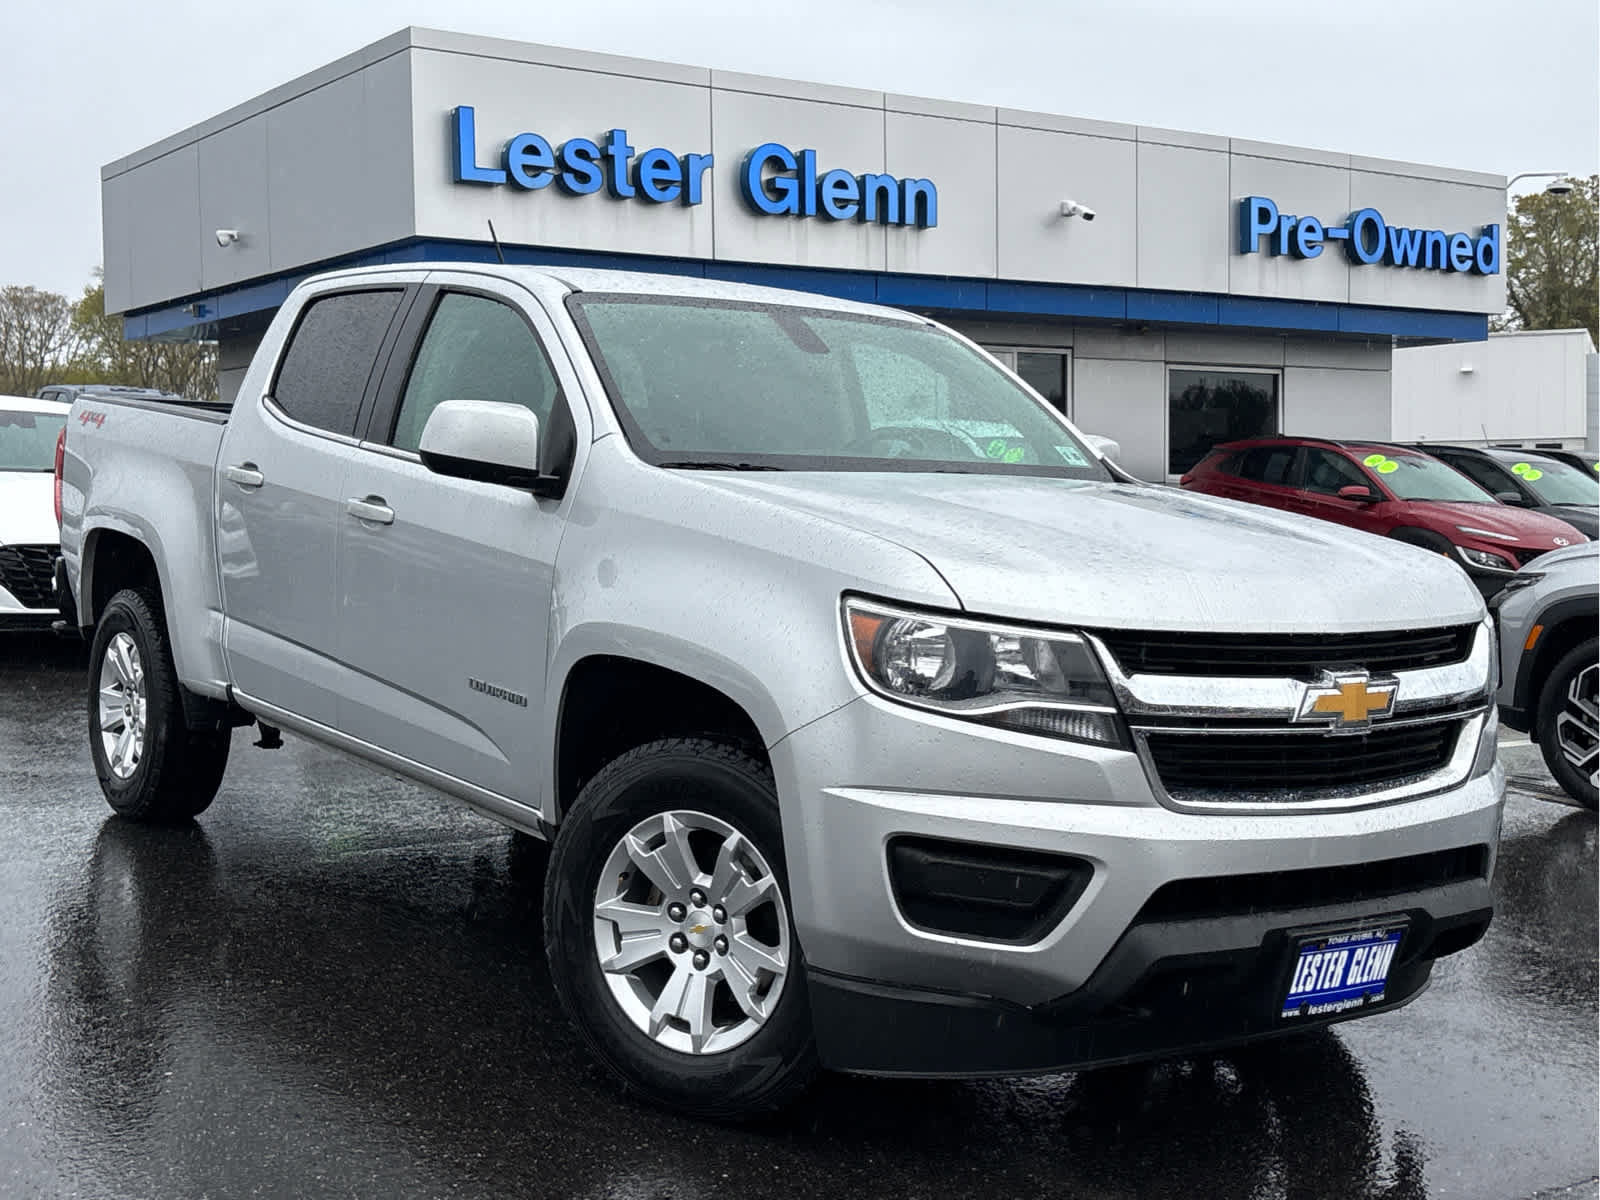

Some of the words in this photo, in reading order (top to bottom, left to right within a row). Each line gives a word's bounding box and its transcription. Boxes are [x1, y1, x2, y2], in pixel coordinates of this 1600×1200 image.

[453, 105, 713, 206] Lester
[740, 143, 938, 228] Glenn
[1240, 196, 1500, 276] Pre-Owned
[1289, 950, 1349, 994] LESTER
[1346, 943, 1397, 986] GLENN
